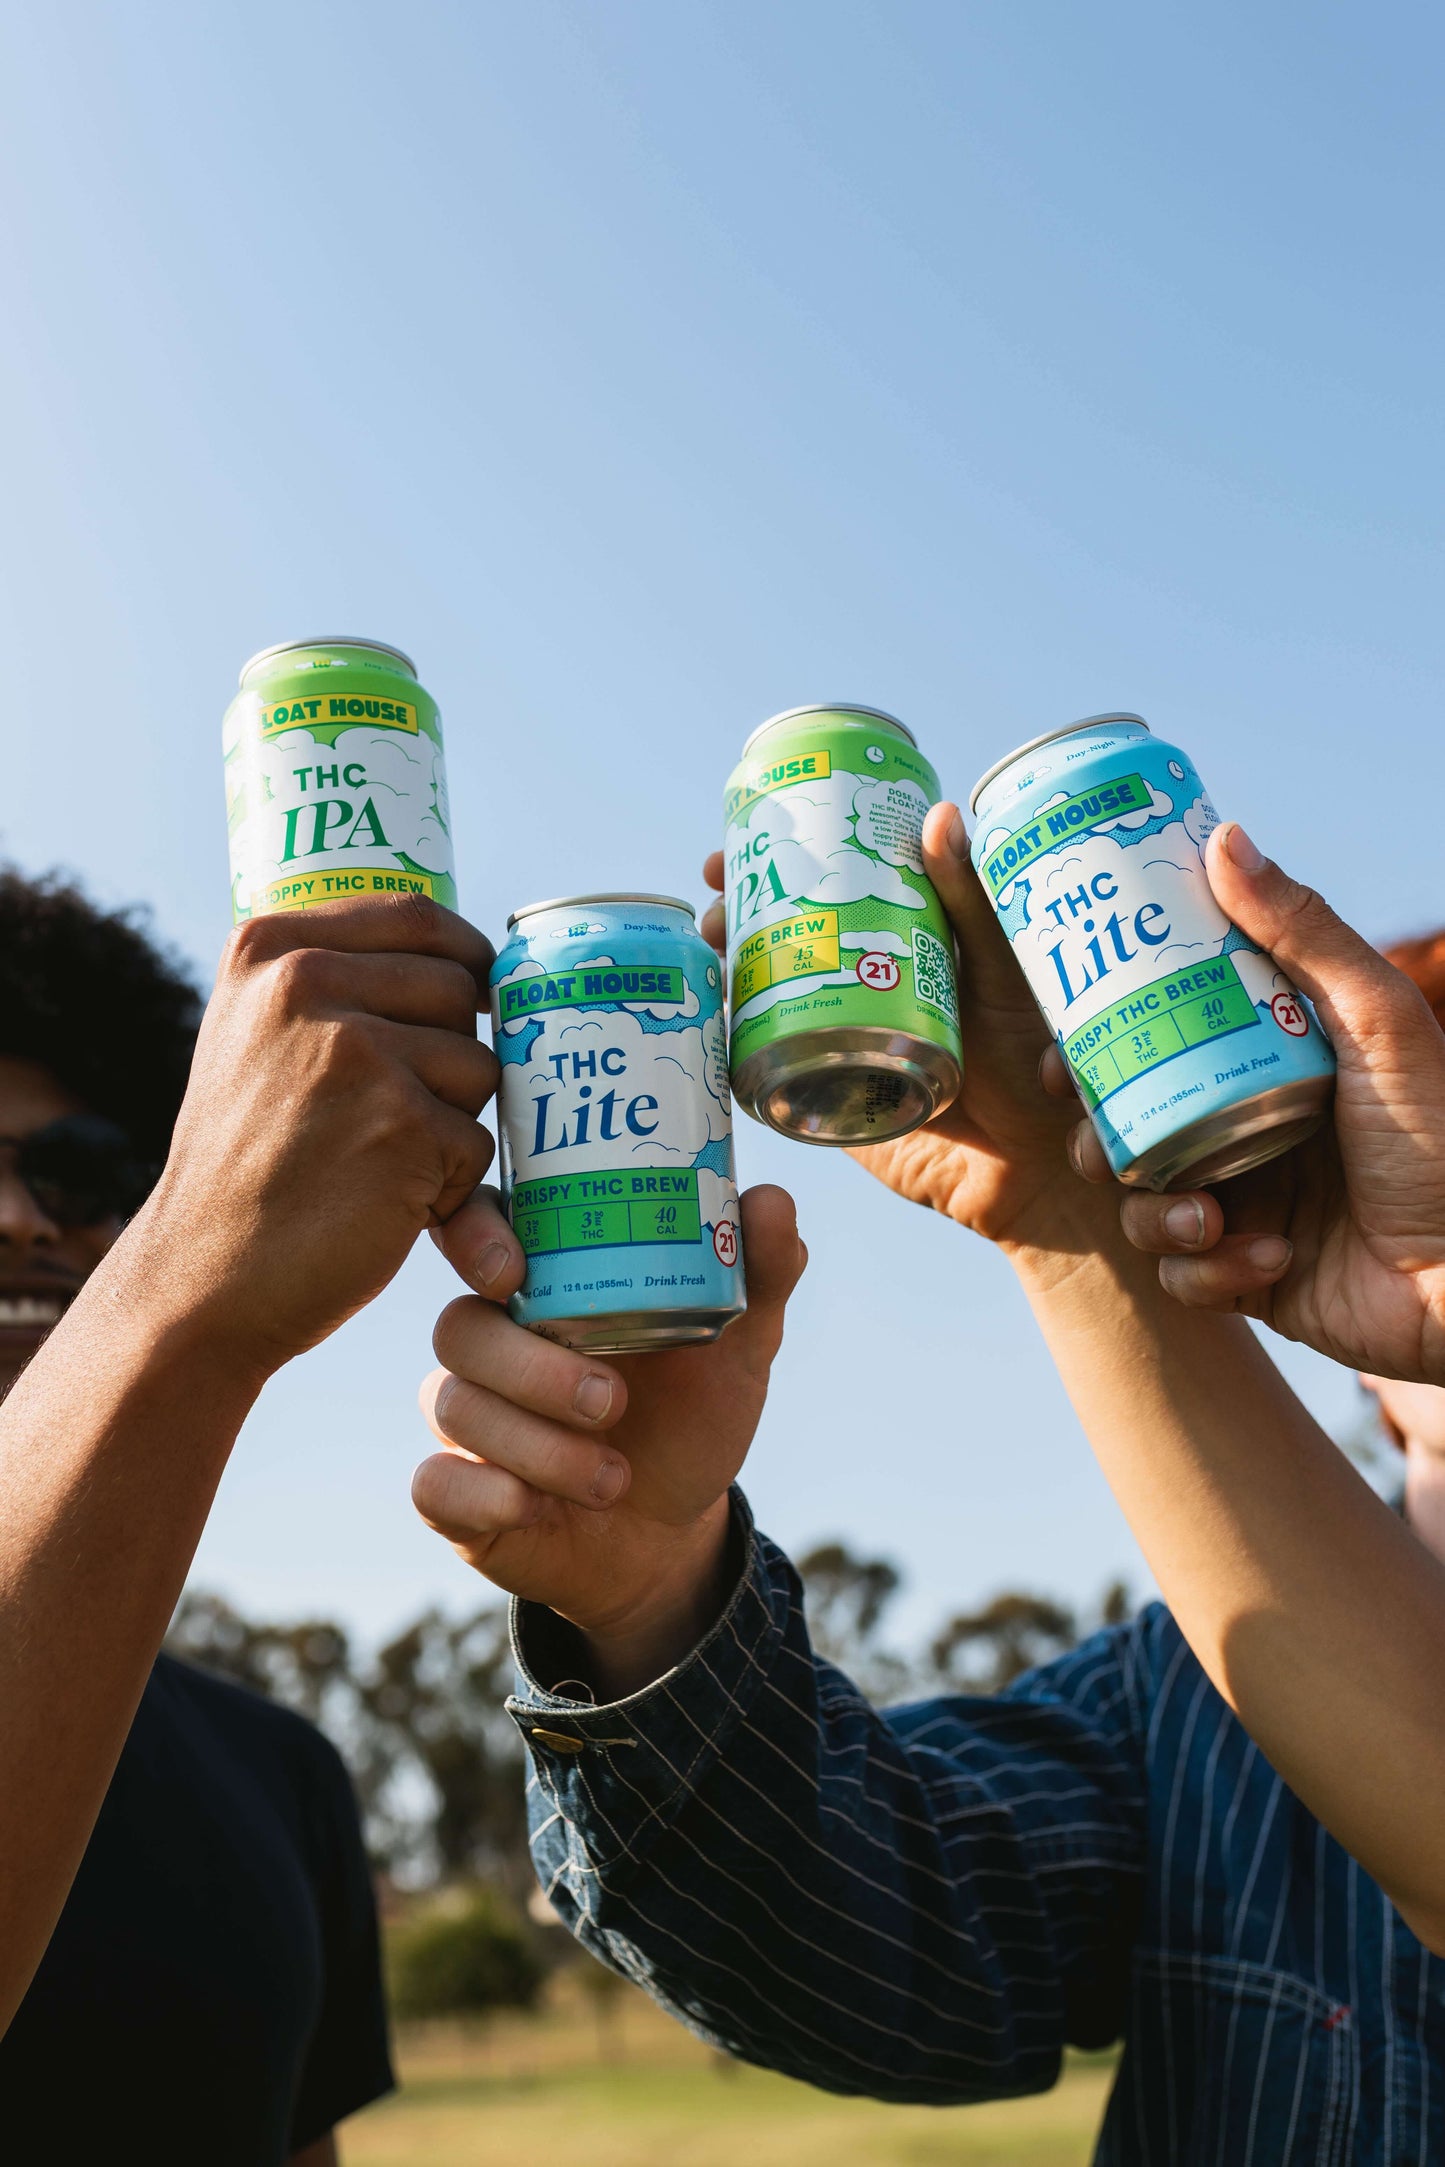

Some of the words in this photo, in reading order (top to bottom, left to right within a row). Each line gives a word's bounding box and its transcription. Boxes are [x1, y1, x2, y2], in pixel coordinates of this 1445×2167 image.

[329, 698, 409, 725] HOUSE
[1066, 740, 1116, 761] Day-Night
[293, 763, 368, 792] THC
[887, 796, 915, 811] FLOAT
[888, 788, 912, 802] DOSE
[871, 803, 886, 811] THC
[278, 796, 393, 865] IPA
[987, 824, 1042, 887] FLOAT
[1046, 783, 1137, 837] HOUSE
[729, 832, 770, 880] THC
[262, 880, 315, 905] OPPY
[322, 875, 366, 893] THC
[373, 875, 426, 895] BREW
[1044, 872, 1119, 925] THC
[624, 923, 672, 933] Day-Night
[739, 937, 765, 965] THC
[771, 918, 826, 945] BREW
[793, 945, 814, 961] 45
[1046, 903, 1171, 1011] Lite
[793, 961, 814, 972] CAL
[506, 976, 577, 1012] FLOAT
[584, 972, 672, 996] HOUSE
[779, 1001, 811, 1018] Drink
[812, 996, 843, 1009] Fresh
[1069, 1017, 1113, 1063] CRISPY
[1116, 993, 1160, 1025] THC
[1164, 965, 1226, 1001] BREW
[1201, 998, 1224, 1019] 40
[1207, 1016, 1231, 1030] CAL
[1131, 1036, 1143, 1054] 3
[549, 1047, 627, 1080] THC
[1136, 1047, 1159, 1064] THC
[1086, 1069, 1095, 1086] 3
[1214, 1063, 1250, 1085] Drink
[1250, 1052, 1280, 1071] Fresh
[1140, 1111, 1151, 1121] 12
[1158, 1101, 1169, 1111] oz
[1169, 1082, 1206, 1107] (355mL)
[528, 1085, 660, 1158] Lite
[1116, 1120, 1134, 1140] Cold
[516, 1183, 571, 1208] CRISPY
[578, 1178, 624, 1198] THC
[631, 1176, 690, 1194] BREW
[581, 1211, 592, 1229] 3
[654, 1206, 677, 1223] 40
[525, 1219, 532, 1237] 3
[581, 1229, 604, 1240] THC
[656, 1225, 678, 1235] CAL
[563, 1284, 573, 1293] 12
[596, 1278, 633, 1291] (355mL)
[644, 1274, 678, 1287] Drink
[680, 1274, 706, 1286] Fresh
[533, 1285, 552, 1298] Cold
